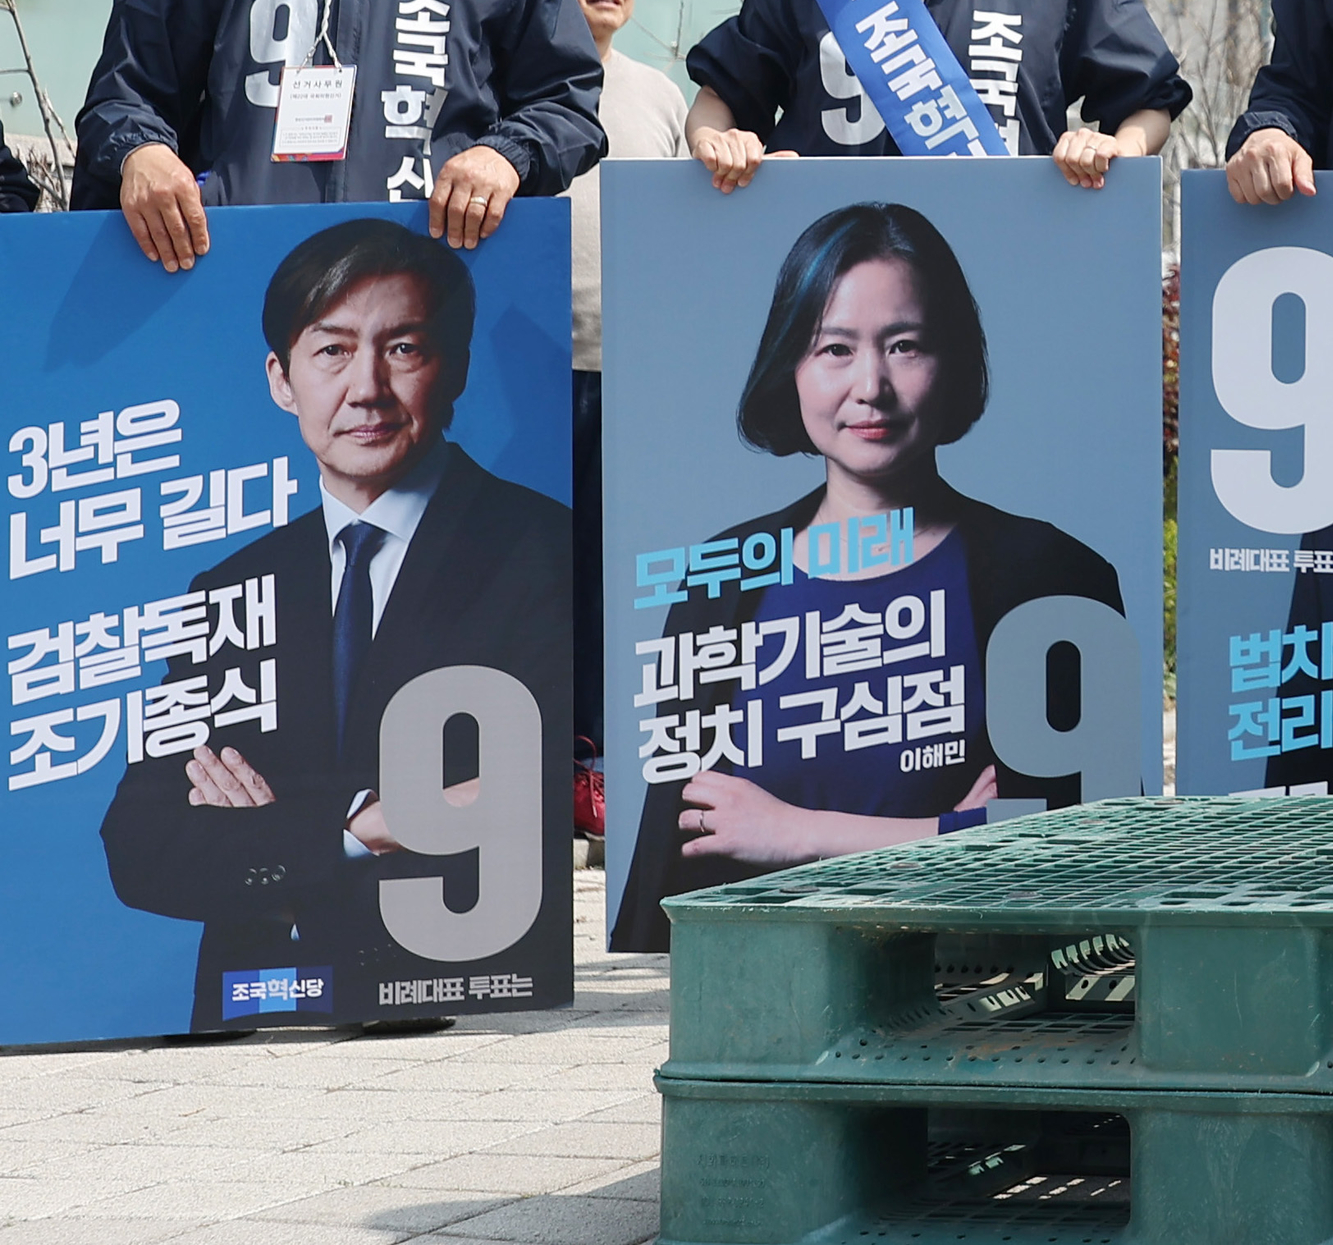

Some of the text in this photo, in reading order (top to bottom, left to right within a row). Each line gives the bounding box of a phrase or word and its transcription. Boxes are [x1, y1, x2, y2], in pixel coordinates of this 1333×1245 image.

[819, 30, 885, 145] 9
[855, 0, 988, 157] 조국혁
[8, 399, 182, 499] 3년은
[10, 456, 298, 580] 너무 길다
[634, 507, 914, 609] 모두의 미래
[1209, 547, 1290, 573] 비례대표
[8, 574, 277, 705] 검찰독재
[634, 590, 946, 708] 과학기술의
[8, 658, 277, 791] 조기종식
[638, 665, 965, 785] 정치 구심점
[899, 740, 965, 773] 이해민
[985, 594, 1142, 823] 9
[379, 664, 543, 962] 9
[232, 978, 324, 1001] 조국혁신당
[379, 973, 533, 1005] 비례대표 투표는
